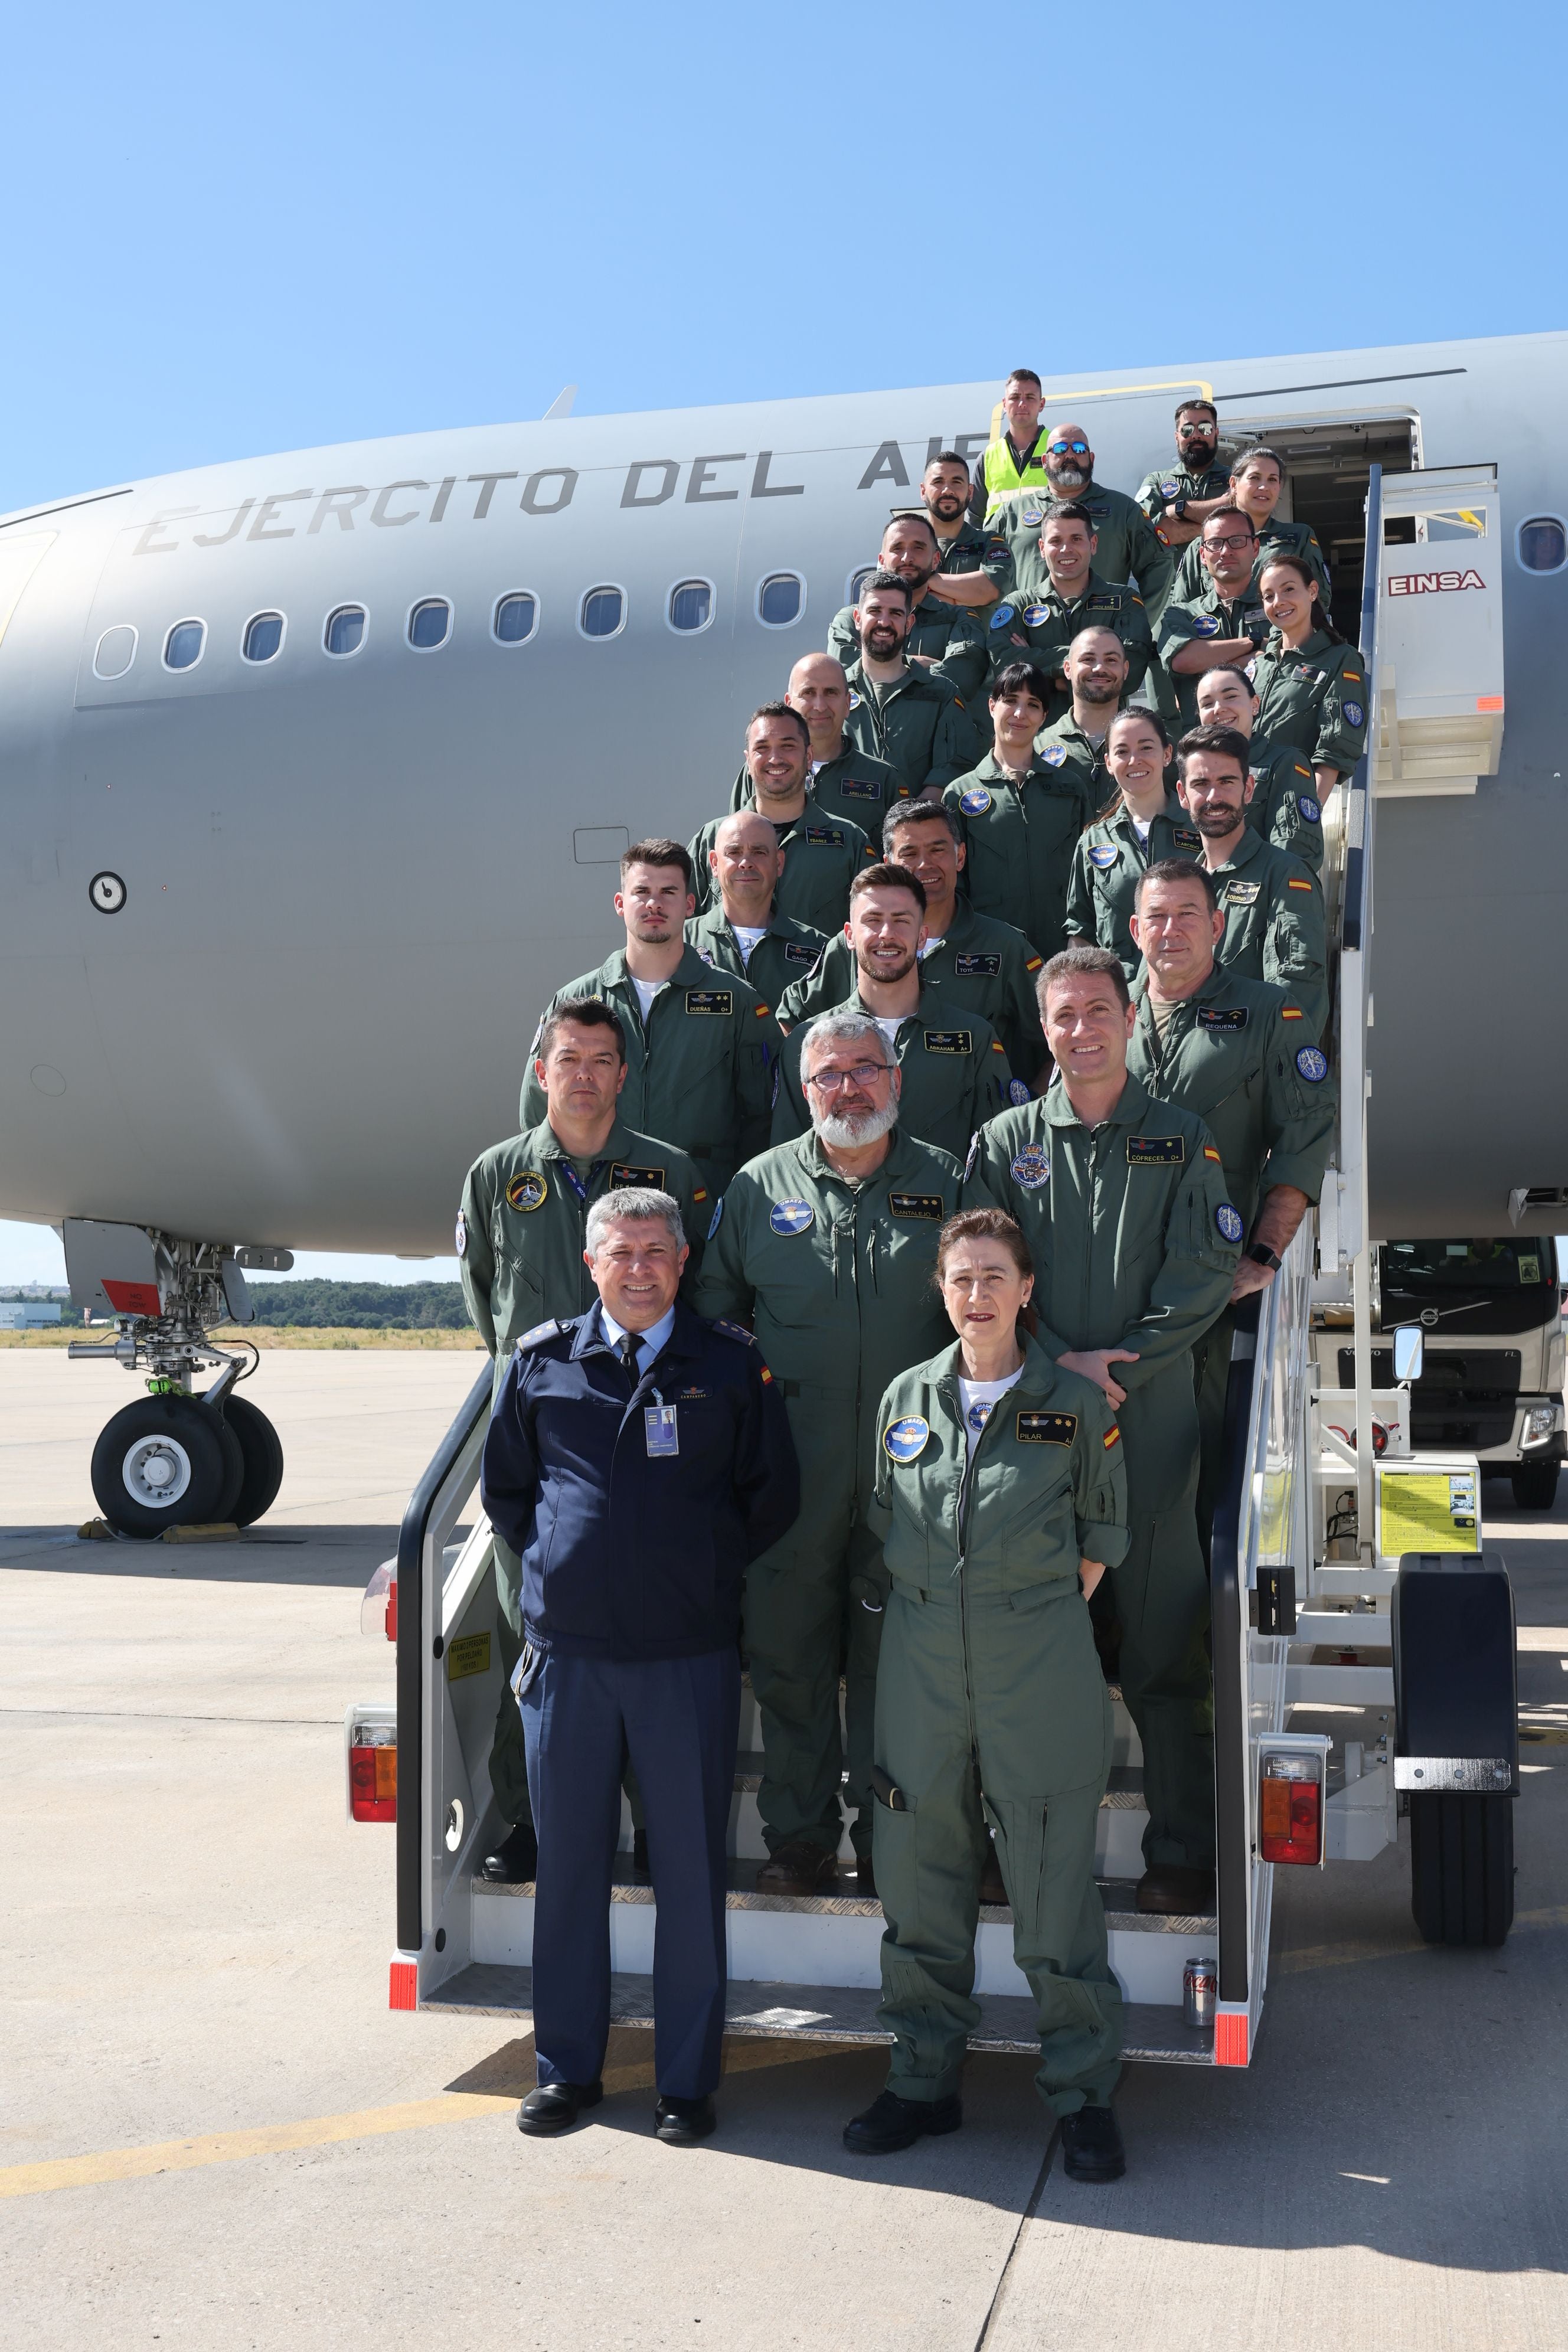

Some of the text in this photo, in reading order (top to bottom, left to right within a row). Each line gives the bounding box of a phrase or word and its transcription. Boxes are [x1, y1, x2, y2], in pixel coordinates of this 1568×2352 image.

[620, 450, 805, 508] DEL
[1389, 570, 1485, 596] EINSA
[1177, 841, 1200, 850] CARCEDO
[902, 1418, 923, 1426] UMAER
[469, 1636, 488, 1648] PERSONAS
